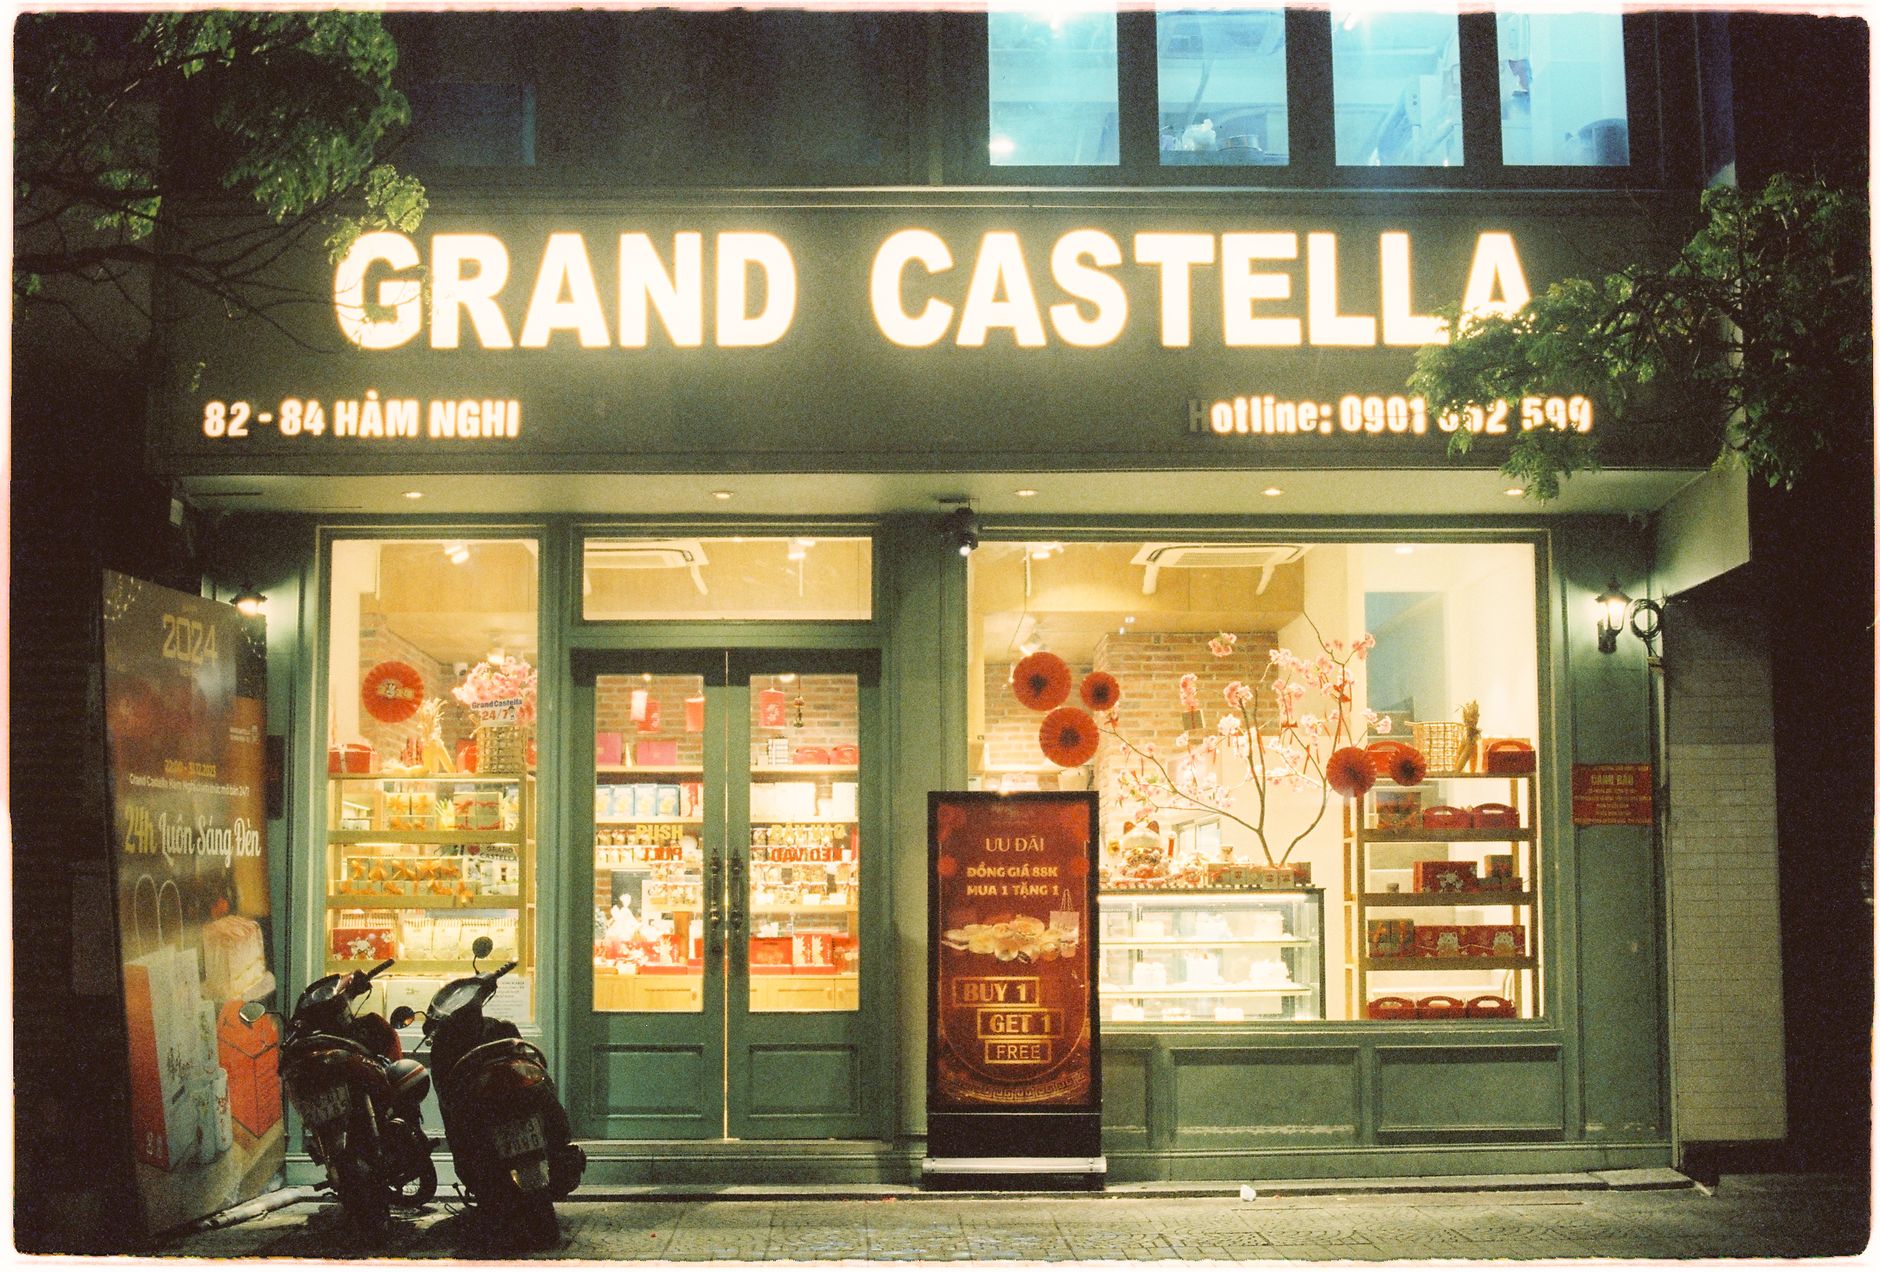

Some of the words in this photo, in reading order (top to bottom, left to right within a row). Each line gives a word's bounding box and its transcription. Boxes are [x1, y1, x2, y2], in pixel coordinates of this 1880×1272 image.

[334, 231, 797, 349] GRAND
[869, 228, 1534, 348] CASTELLA
[203, 399, 251, 438] 82
[280, 396, 326, 438] 84
[333, 389, 420, 438] HÀM
[428, 398, 521, 438] NGHI
[1189, 393, 1333, 435] Hotline:
[1339, 394, 1428, 435] 0901
[1521, 394, 1594, 433] 599
[162, 612, 219, 666] 2024
[123, 803, 158, 855] 24h
[159, 812, 196, 867] Luôn
[197, 814, 233, 868] Sáng
[234, 817, 262, 857] Đèn
[636, 824, 684, 841] PUSH
[1007, 863, 1030, 878] GIÁ
[1032, 867, 1058, 878] 88K
[966, 885, 997, 896] MUA
[1001, 885, 1009, 896] 1
[1052, 885, 1060, 896] 1
[963, 983, 1007, 1002] BUY
[1016, 983, 1027, 1002] 1
[989, 1014, 1032, 1033] GET
[1041, 1015, 1051, 1033] 1
[996, 1044, 1041, 1059] FREE
